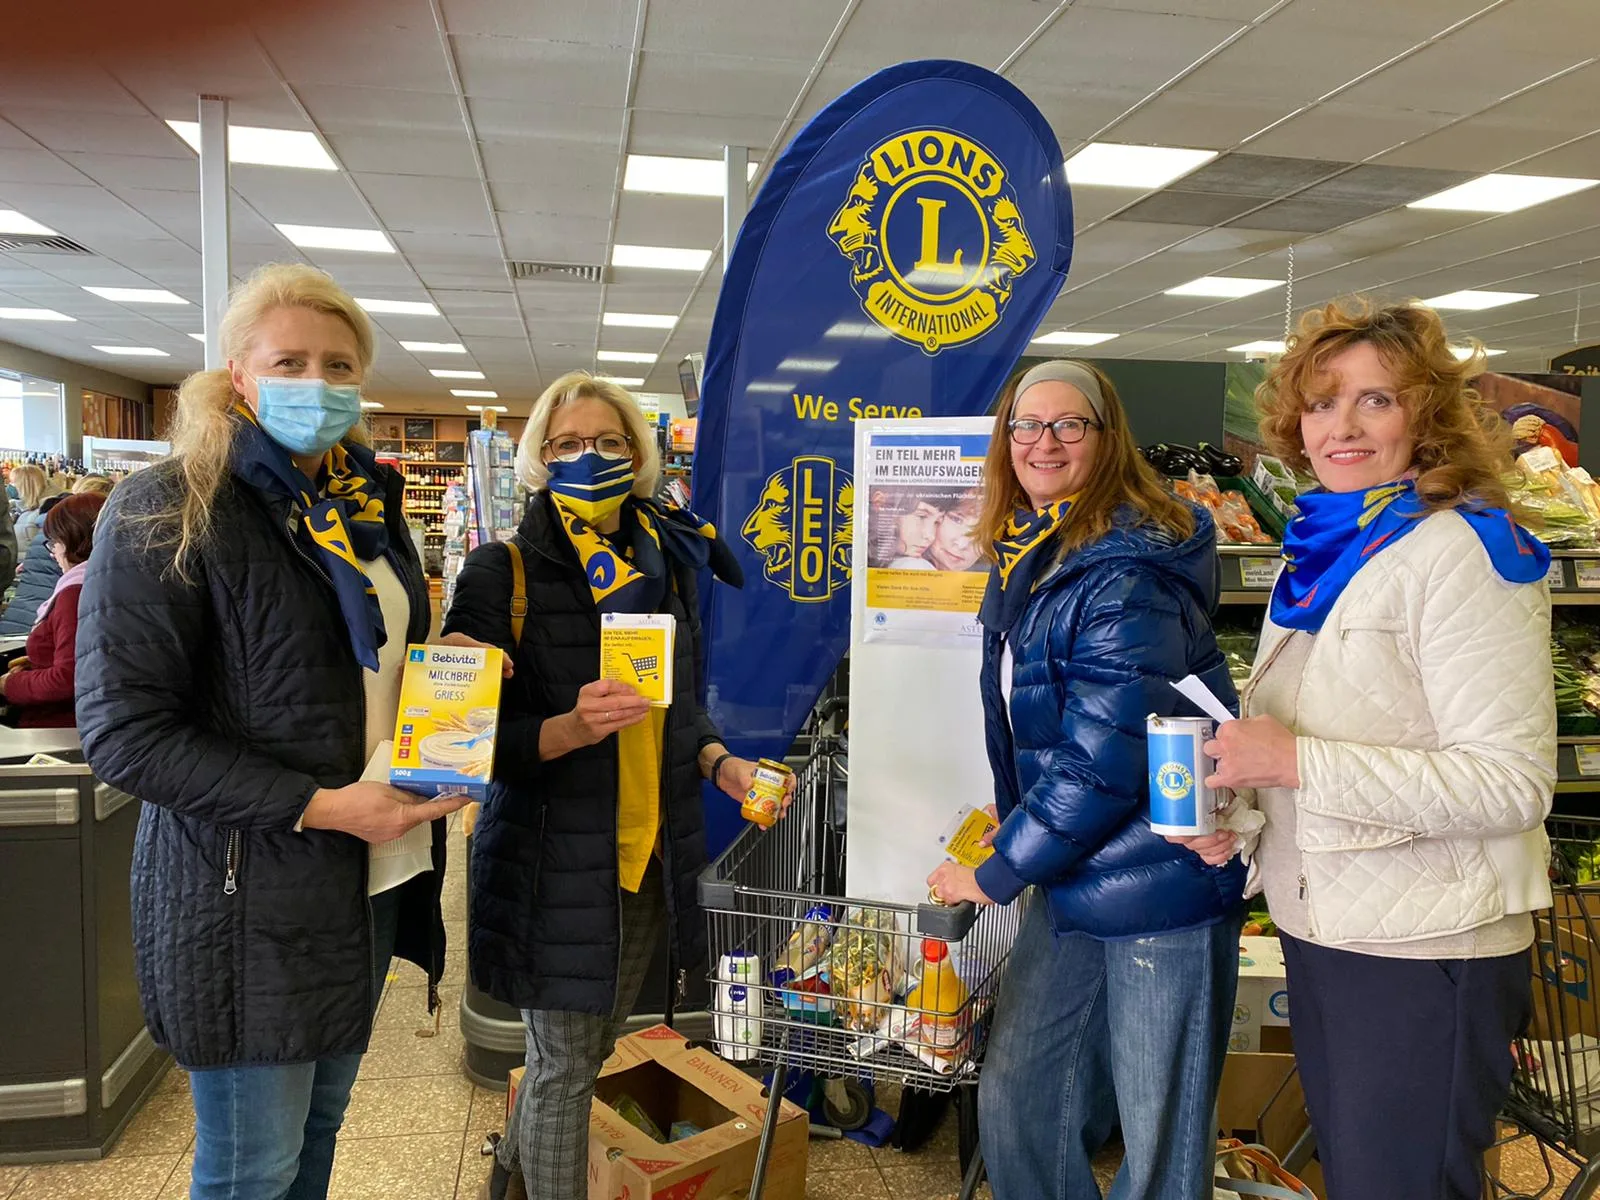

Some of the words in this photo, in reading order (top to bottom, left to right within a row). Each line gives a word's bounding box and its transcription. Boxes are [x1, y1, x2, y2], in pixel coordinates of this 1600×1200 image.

[880, 136, 996, 190] LIONS
[914, 197, 964, 274] L
[875, 290, 989, 335] INTERNATIONAL
[792, 394, 839, 421] We
[848, 397, 922, 422] Serve
[875, 449, 893, 460] EIN
[896, 449, 919, 460] TEIL
[923, 449, 956, 460] MEHR
[875, 465, 889, 476] IM
[800, 468, 824, 583] LEO
[432, 653, 476, 665] Bebivita
[429, 670, 477, 682] MILCHBREI
[434, 690, 465, 701] GRIESS
[1169, 774, 1180, 787] L
[686, 1056, 744, 1094] BANANEN
[591, 1111, 625, 1140] BANA
